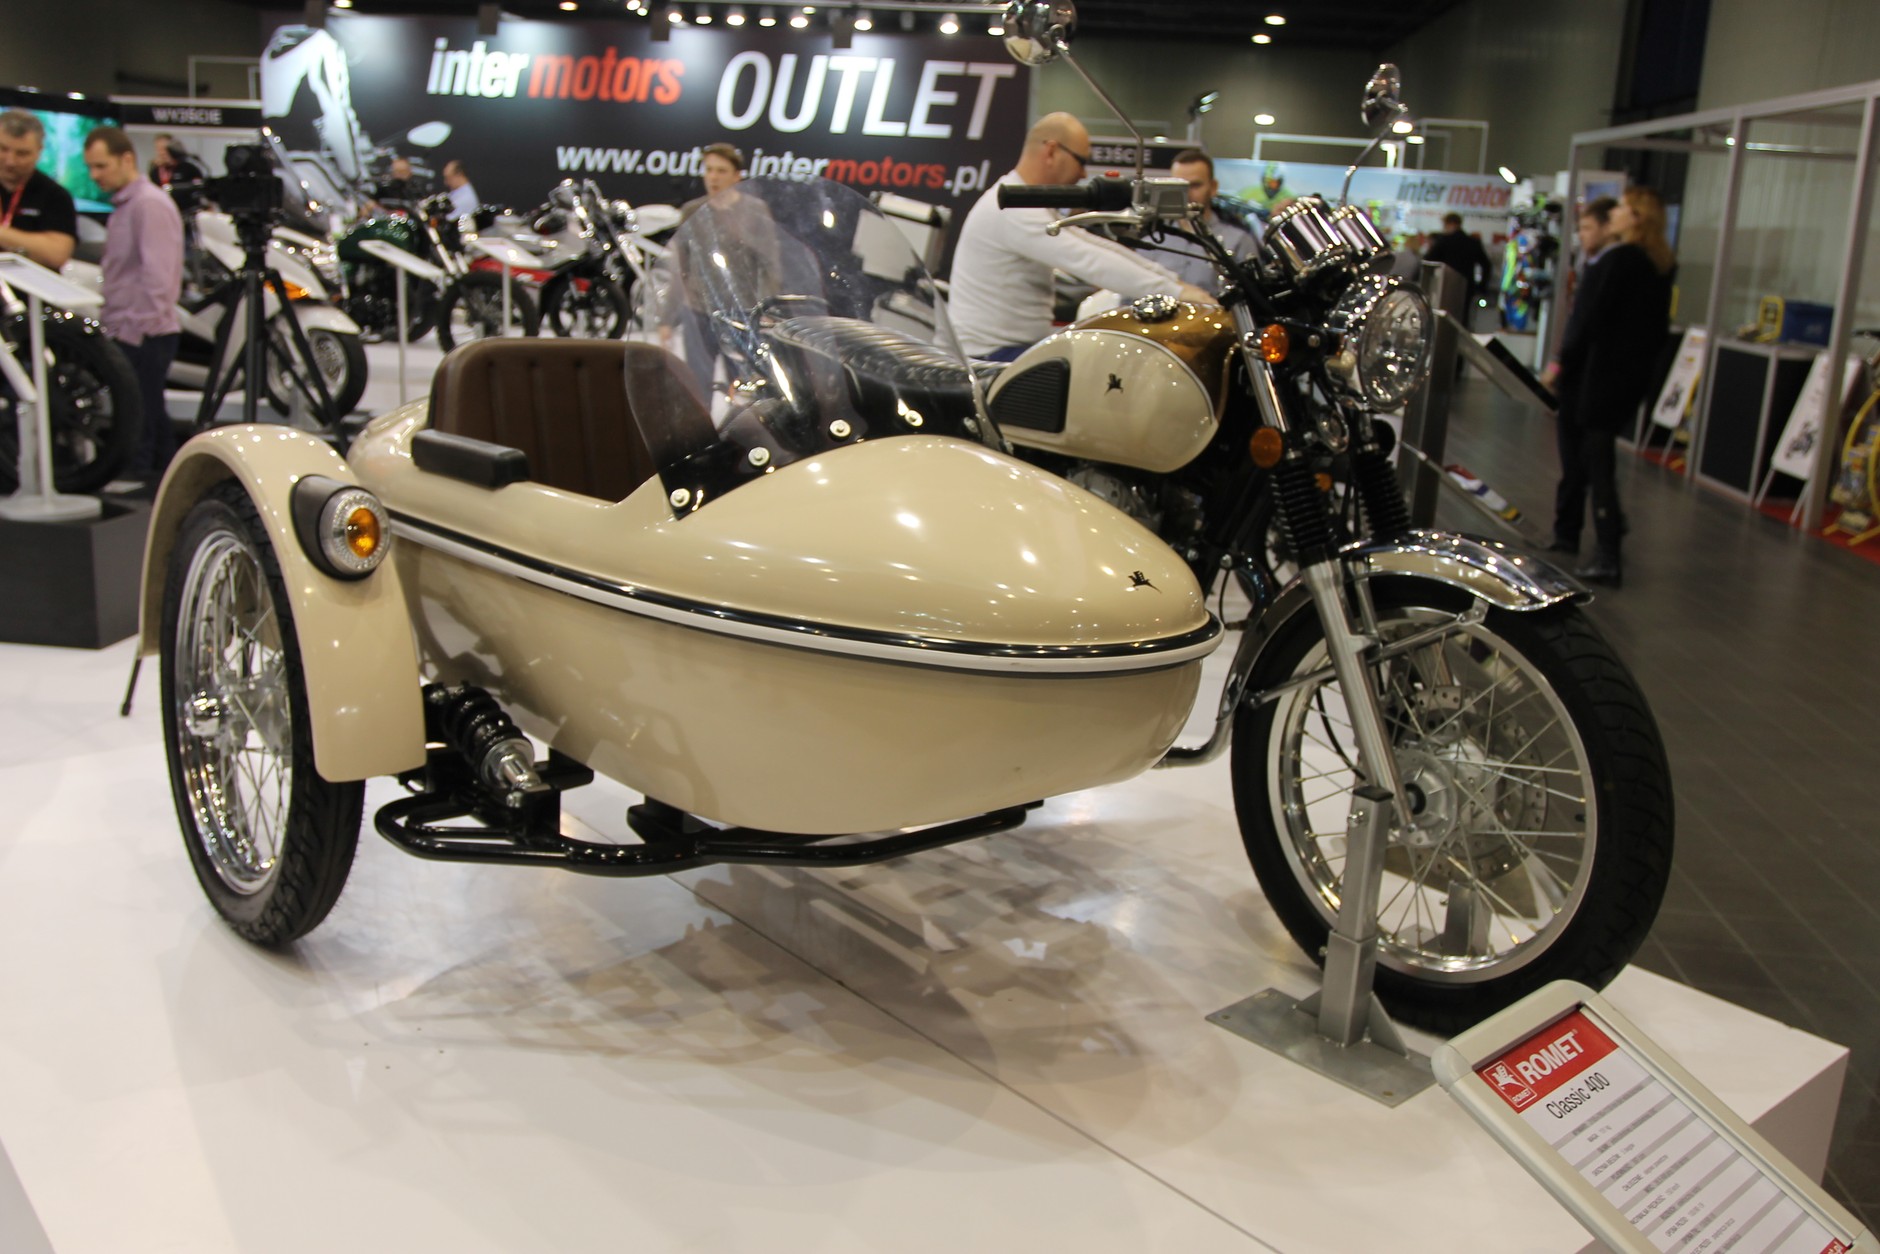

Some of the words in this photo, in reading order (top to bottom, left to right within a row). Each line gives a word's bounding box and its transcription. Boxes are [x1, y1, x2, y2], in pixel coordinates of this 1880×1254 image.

[426, 37, 530, 98] inter
[527, 46, 686, 106] motors
[715, 50, 1017, 141] OUTLET
[556, 145, 990, 197] www.out.intermotors.pl
[1515, 1030, 1584, 1085] ROMET
[1545, 1087, 1591, 1119] Classic
[1583, 1071, 1610, 1093] 400
